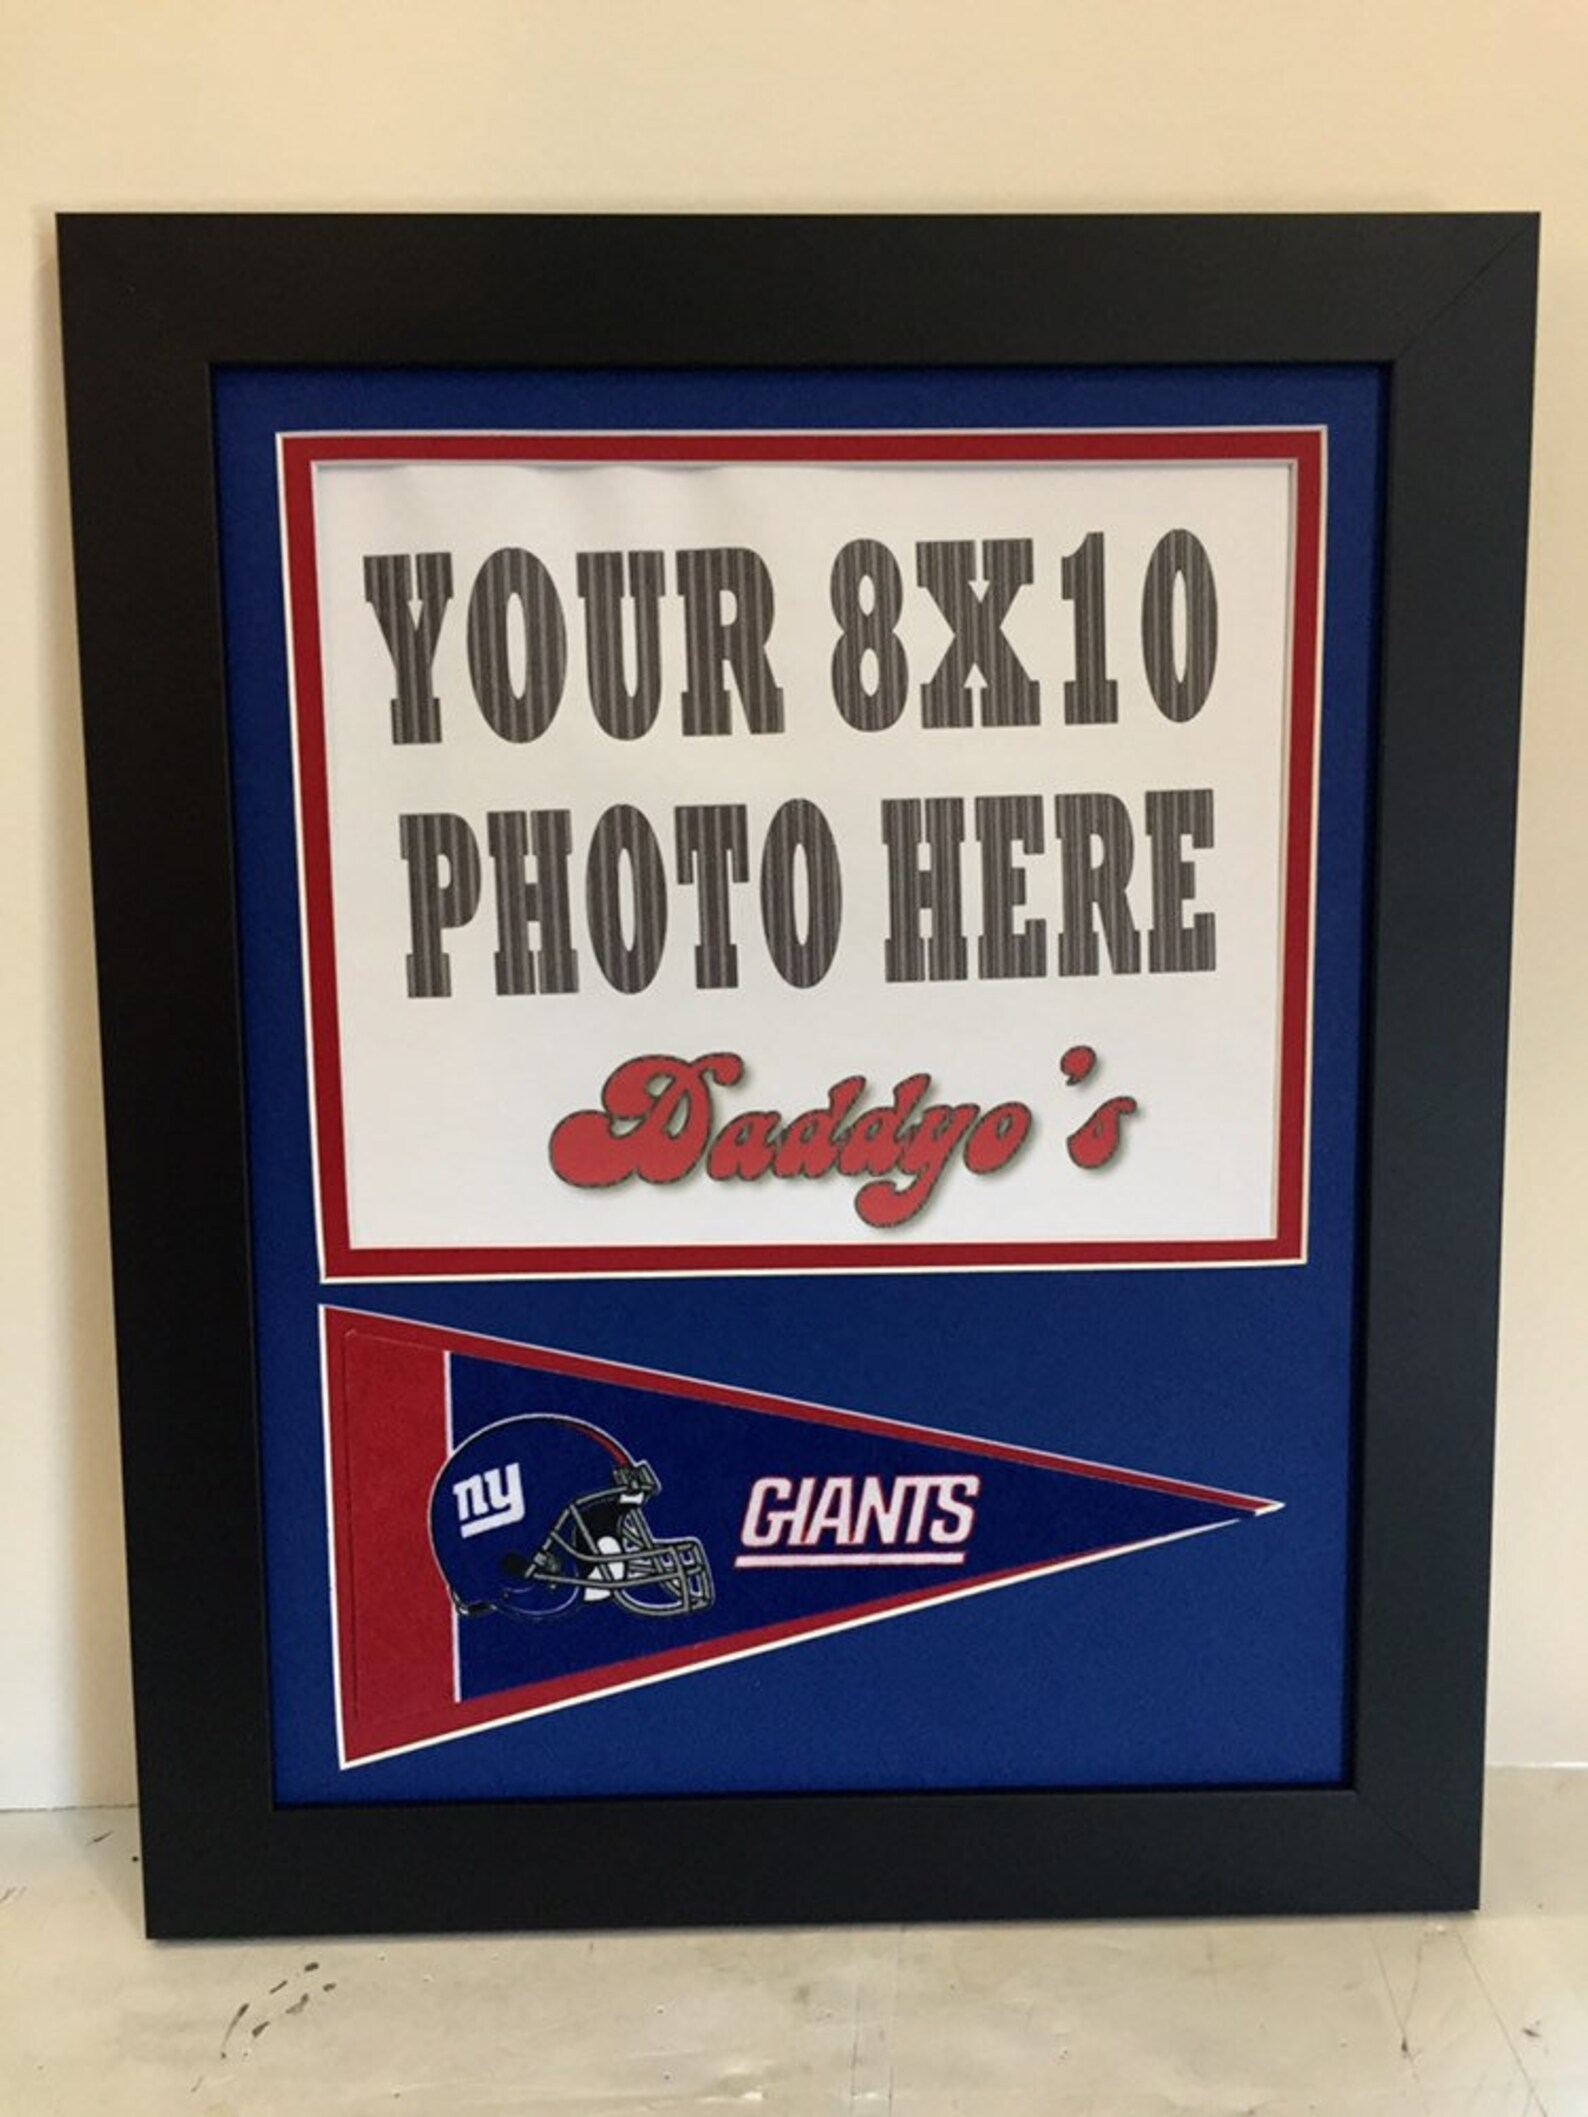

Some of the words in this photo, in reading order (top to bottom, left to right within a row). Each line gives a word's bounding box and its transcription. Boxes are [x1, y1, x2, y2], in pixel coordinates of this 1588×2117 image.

[363, 546, 785, 744] YOUR
[830, 528, 1219, 732] 8X10
[398, 798, 842, 998] PHOTO
[881, 789, 1216, 982] HERE
[739, 1474, 980, 1549] GIANTS
